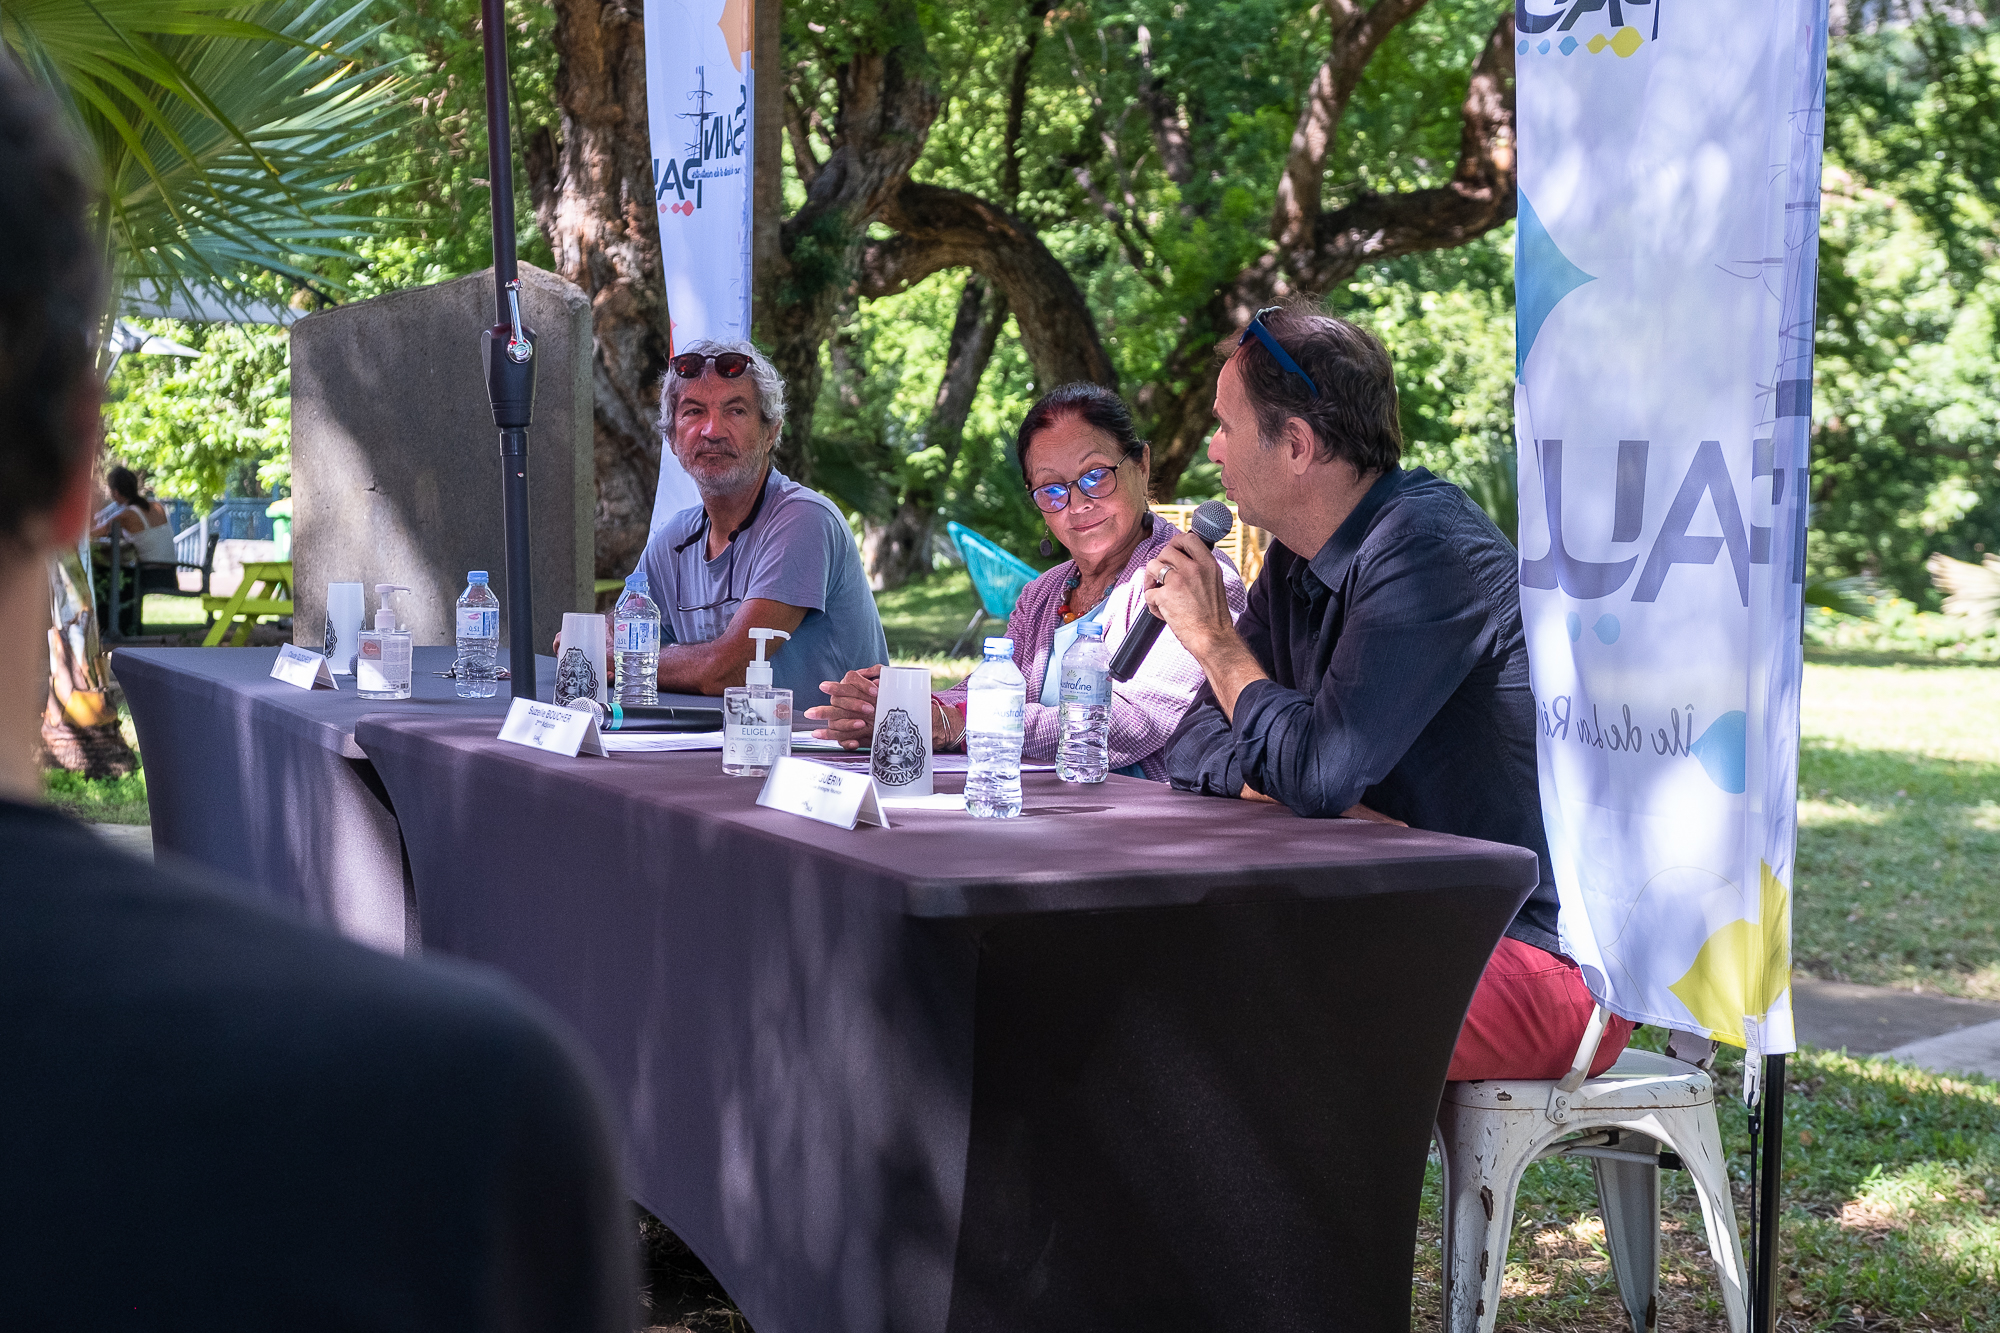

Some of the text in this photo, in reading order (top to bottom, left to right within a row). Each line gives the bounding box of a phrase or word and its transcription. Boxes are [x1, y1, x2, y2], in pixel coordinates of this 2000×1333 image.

[546, 709, 572, 723] BOUCHER
[741, 728, 777, 736] ELIGEL A
